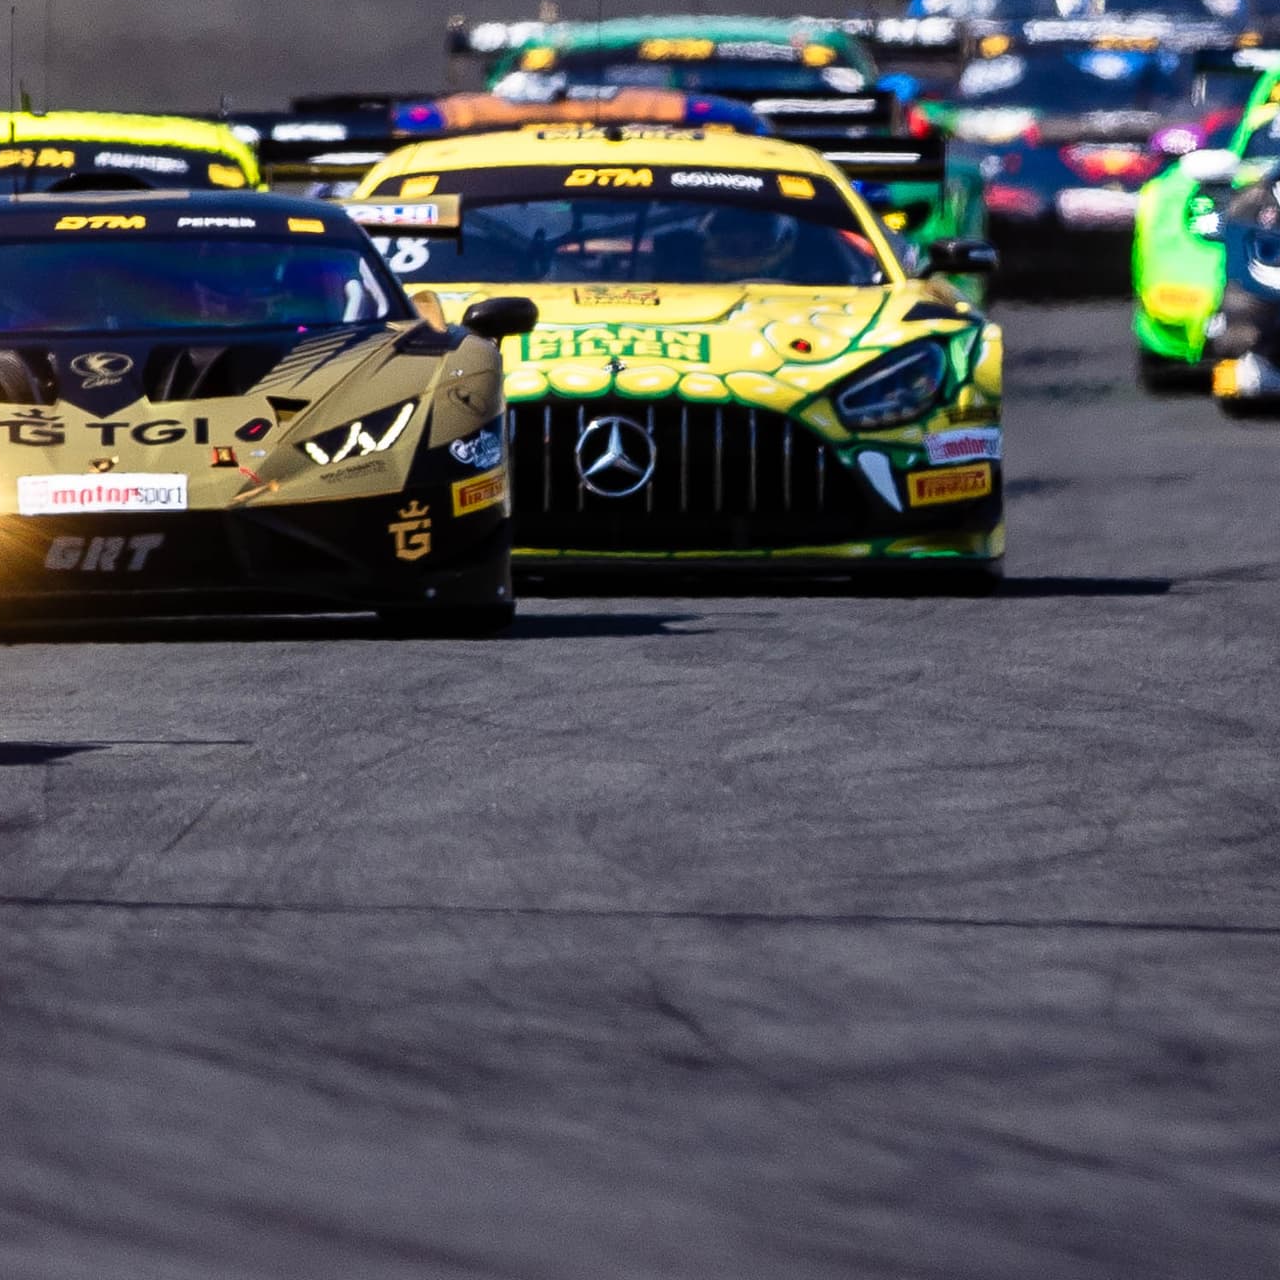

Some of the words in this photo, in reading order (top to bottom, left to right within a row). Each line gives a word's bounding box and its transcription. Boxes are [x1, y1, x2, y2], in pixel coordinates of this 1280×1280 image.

[564, 168, 654, 187] DTM
[670, 172, 764, 191] GOUNON
[55, 216, 147, 231] DTM
[177, 217, 256, 228] PEPPER
[85, 418, 209, 447] TGI
[52, 485, 183, 505] motorsport
